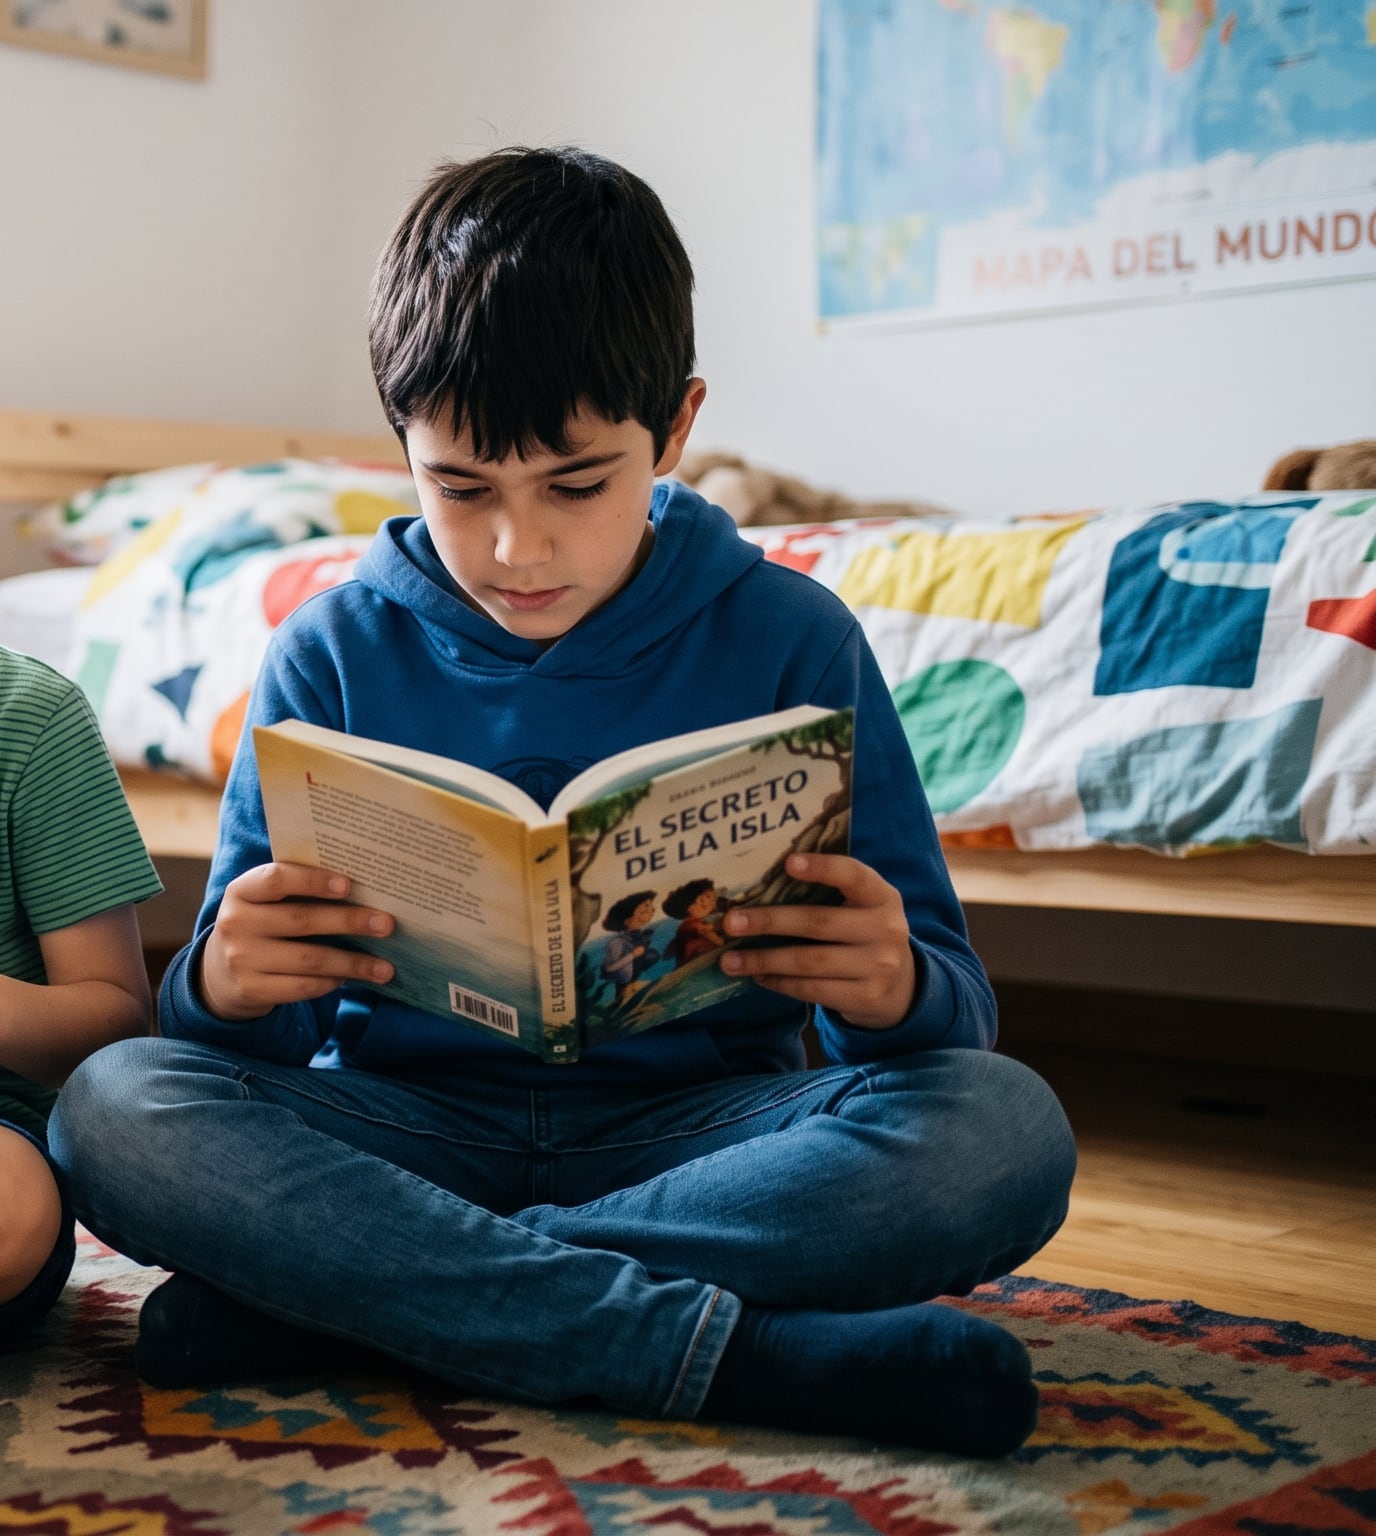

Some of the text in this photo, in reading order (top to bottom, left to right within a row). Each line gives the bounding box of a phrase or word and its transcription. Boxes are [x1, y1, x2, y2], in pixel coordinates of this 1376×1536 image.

[972, 245, 1093, 292] MAPA
[1111, 232, 1196, 279] DEL
[614, 826, 651, 855] EL
[659, 769, 808, 839] SECRETO
[625, 802, 802, 881] DE LA ISLA
[549, 954, 566, 999] SECRETO
